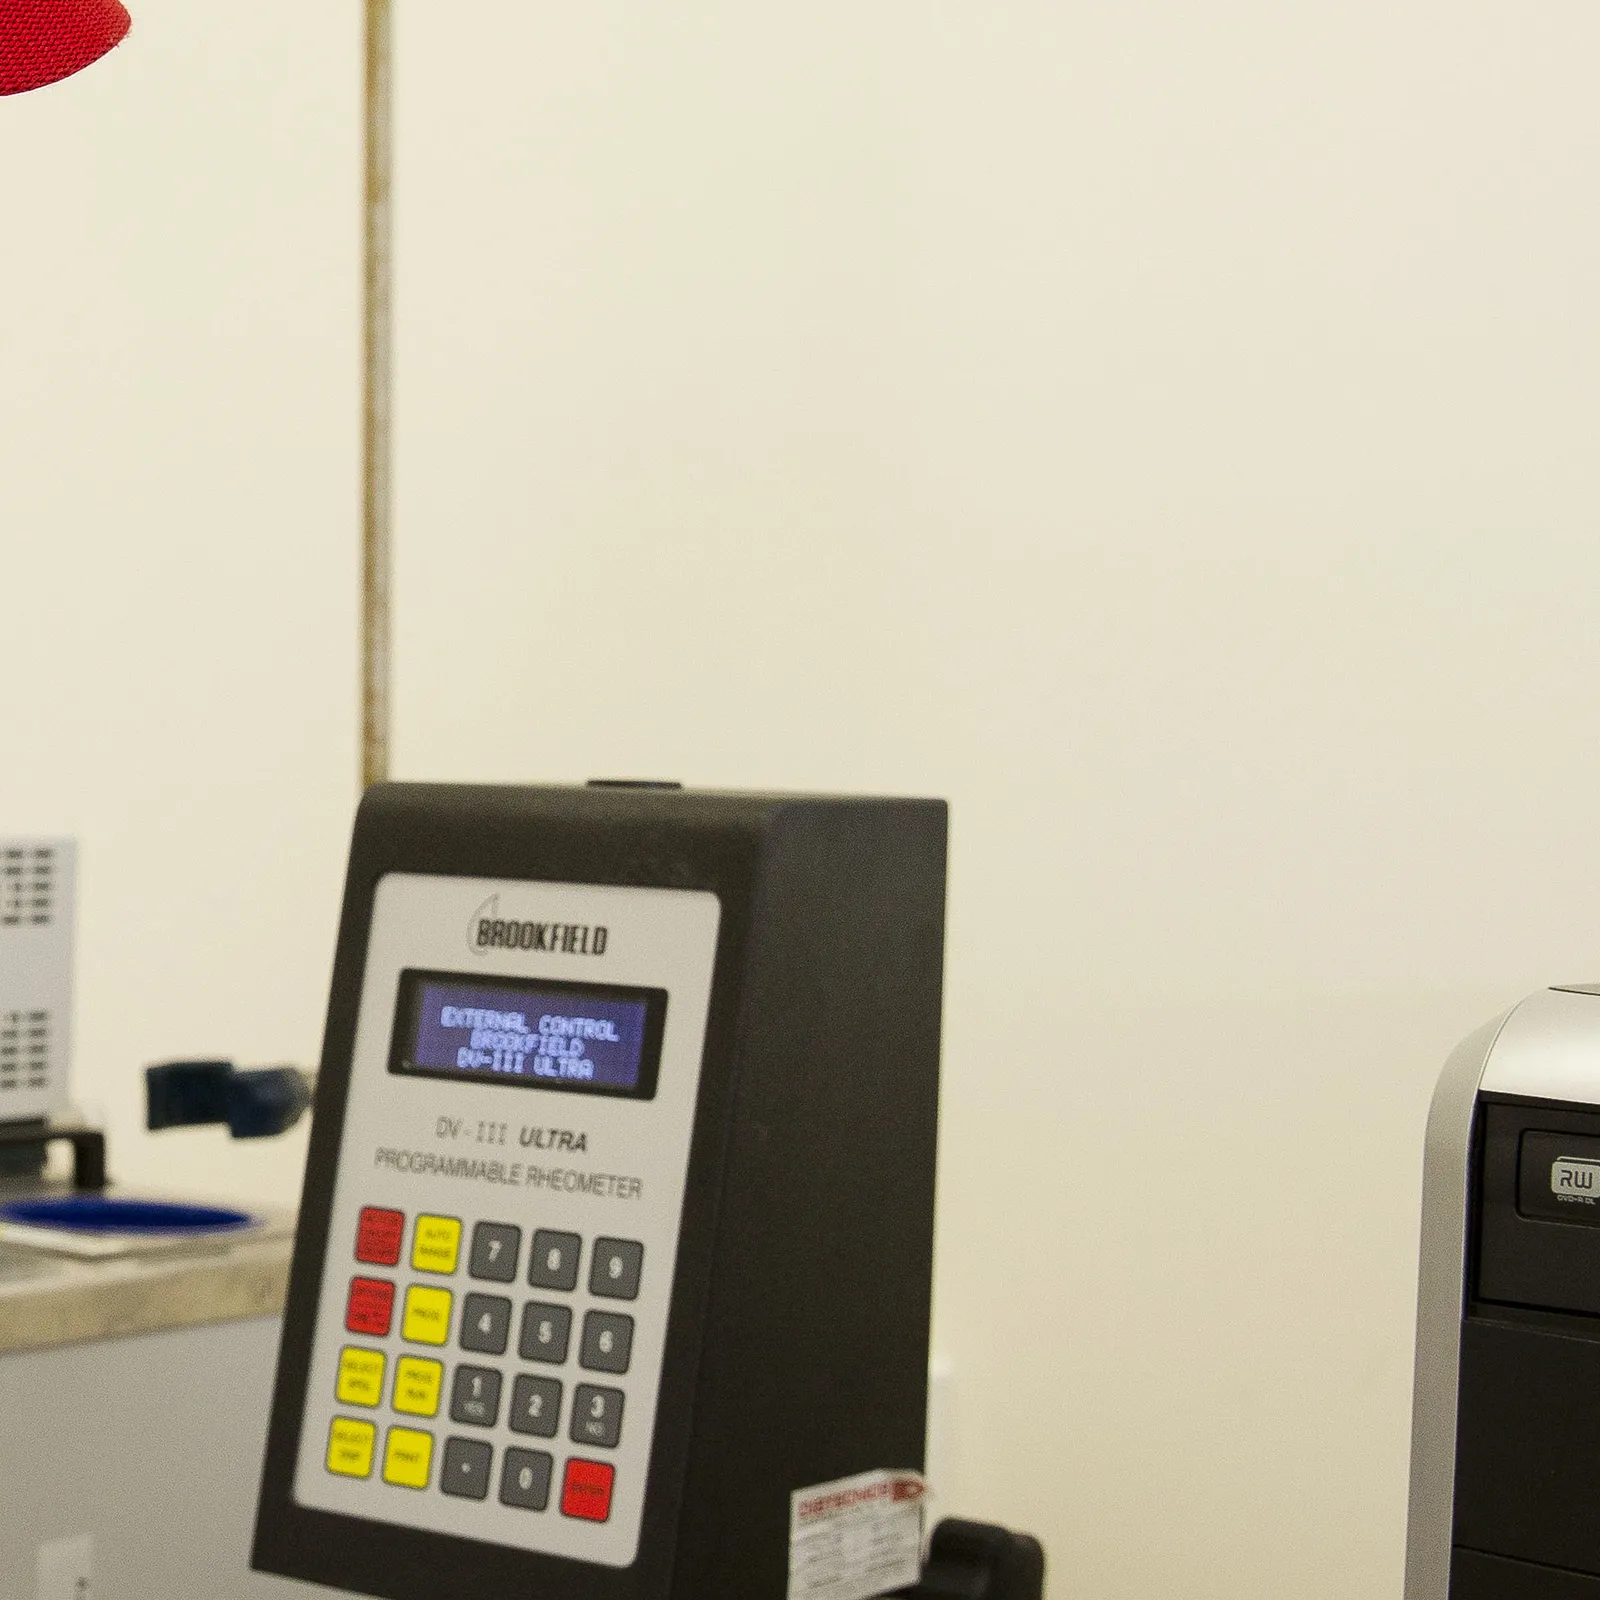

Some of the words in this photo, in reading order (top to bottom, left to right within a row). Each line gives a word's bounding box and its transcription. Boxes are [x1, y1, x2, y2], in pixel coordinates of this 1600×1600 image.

[476, 919, 608, 955] BROOKFIELD
[441, 1006, 530, 1034] EXTERNAL
[538, 1015, 619, 1042] CONTROL
[470, 1028, 584, 1057] BROOKFIELD
[457, 1047, 524, 1074] DV-III
[534, 1055, 594, 1080] ULTRA
[519, 1125, 588, 1153] ULTRA
[374, 1147, 523, 1186] PROGRAMMABLE
[525, 1164, 643, 1199] RHEOMETER
[1560, 1169, 1593, 1189] RW
[488, 1240, 502, 1262] 7
[547, 1248, 561, 1271] 8
[609, 1256, 623, 1279] 9
[478, 1313, 492, 1333] 4
[538, 1320, 551, 1343] 5
[599, 1330, 613, 1353] 6
[472, 1376, 482, 1397] 1
[528, 1394, 542, 1417] 2
[590, 1395, 604, 1418] 3
[519, 1467, 532, 1489] 0
